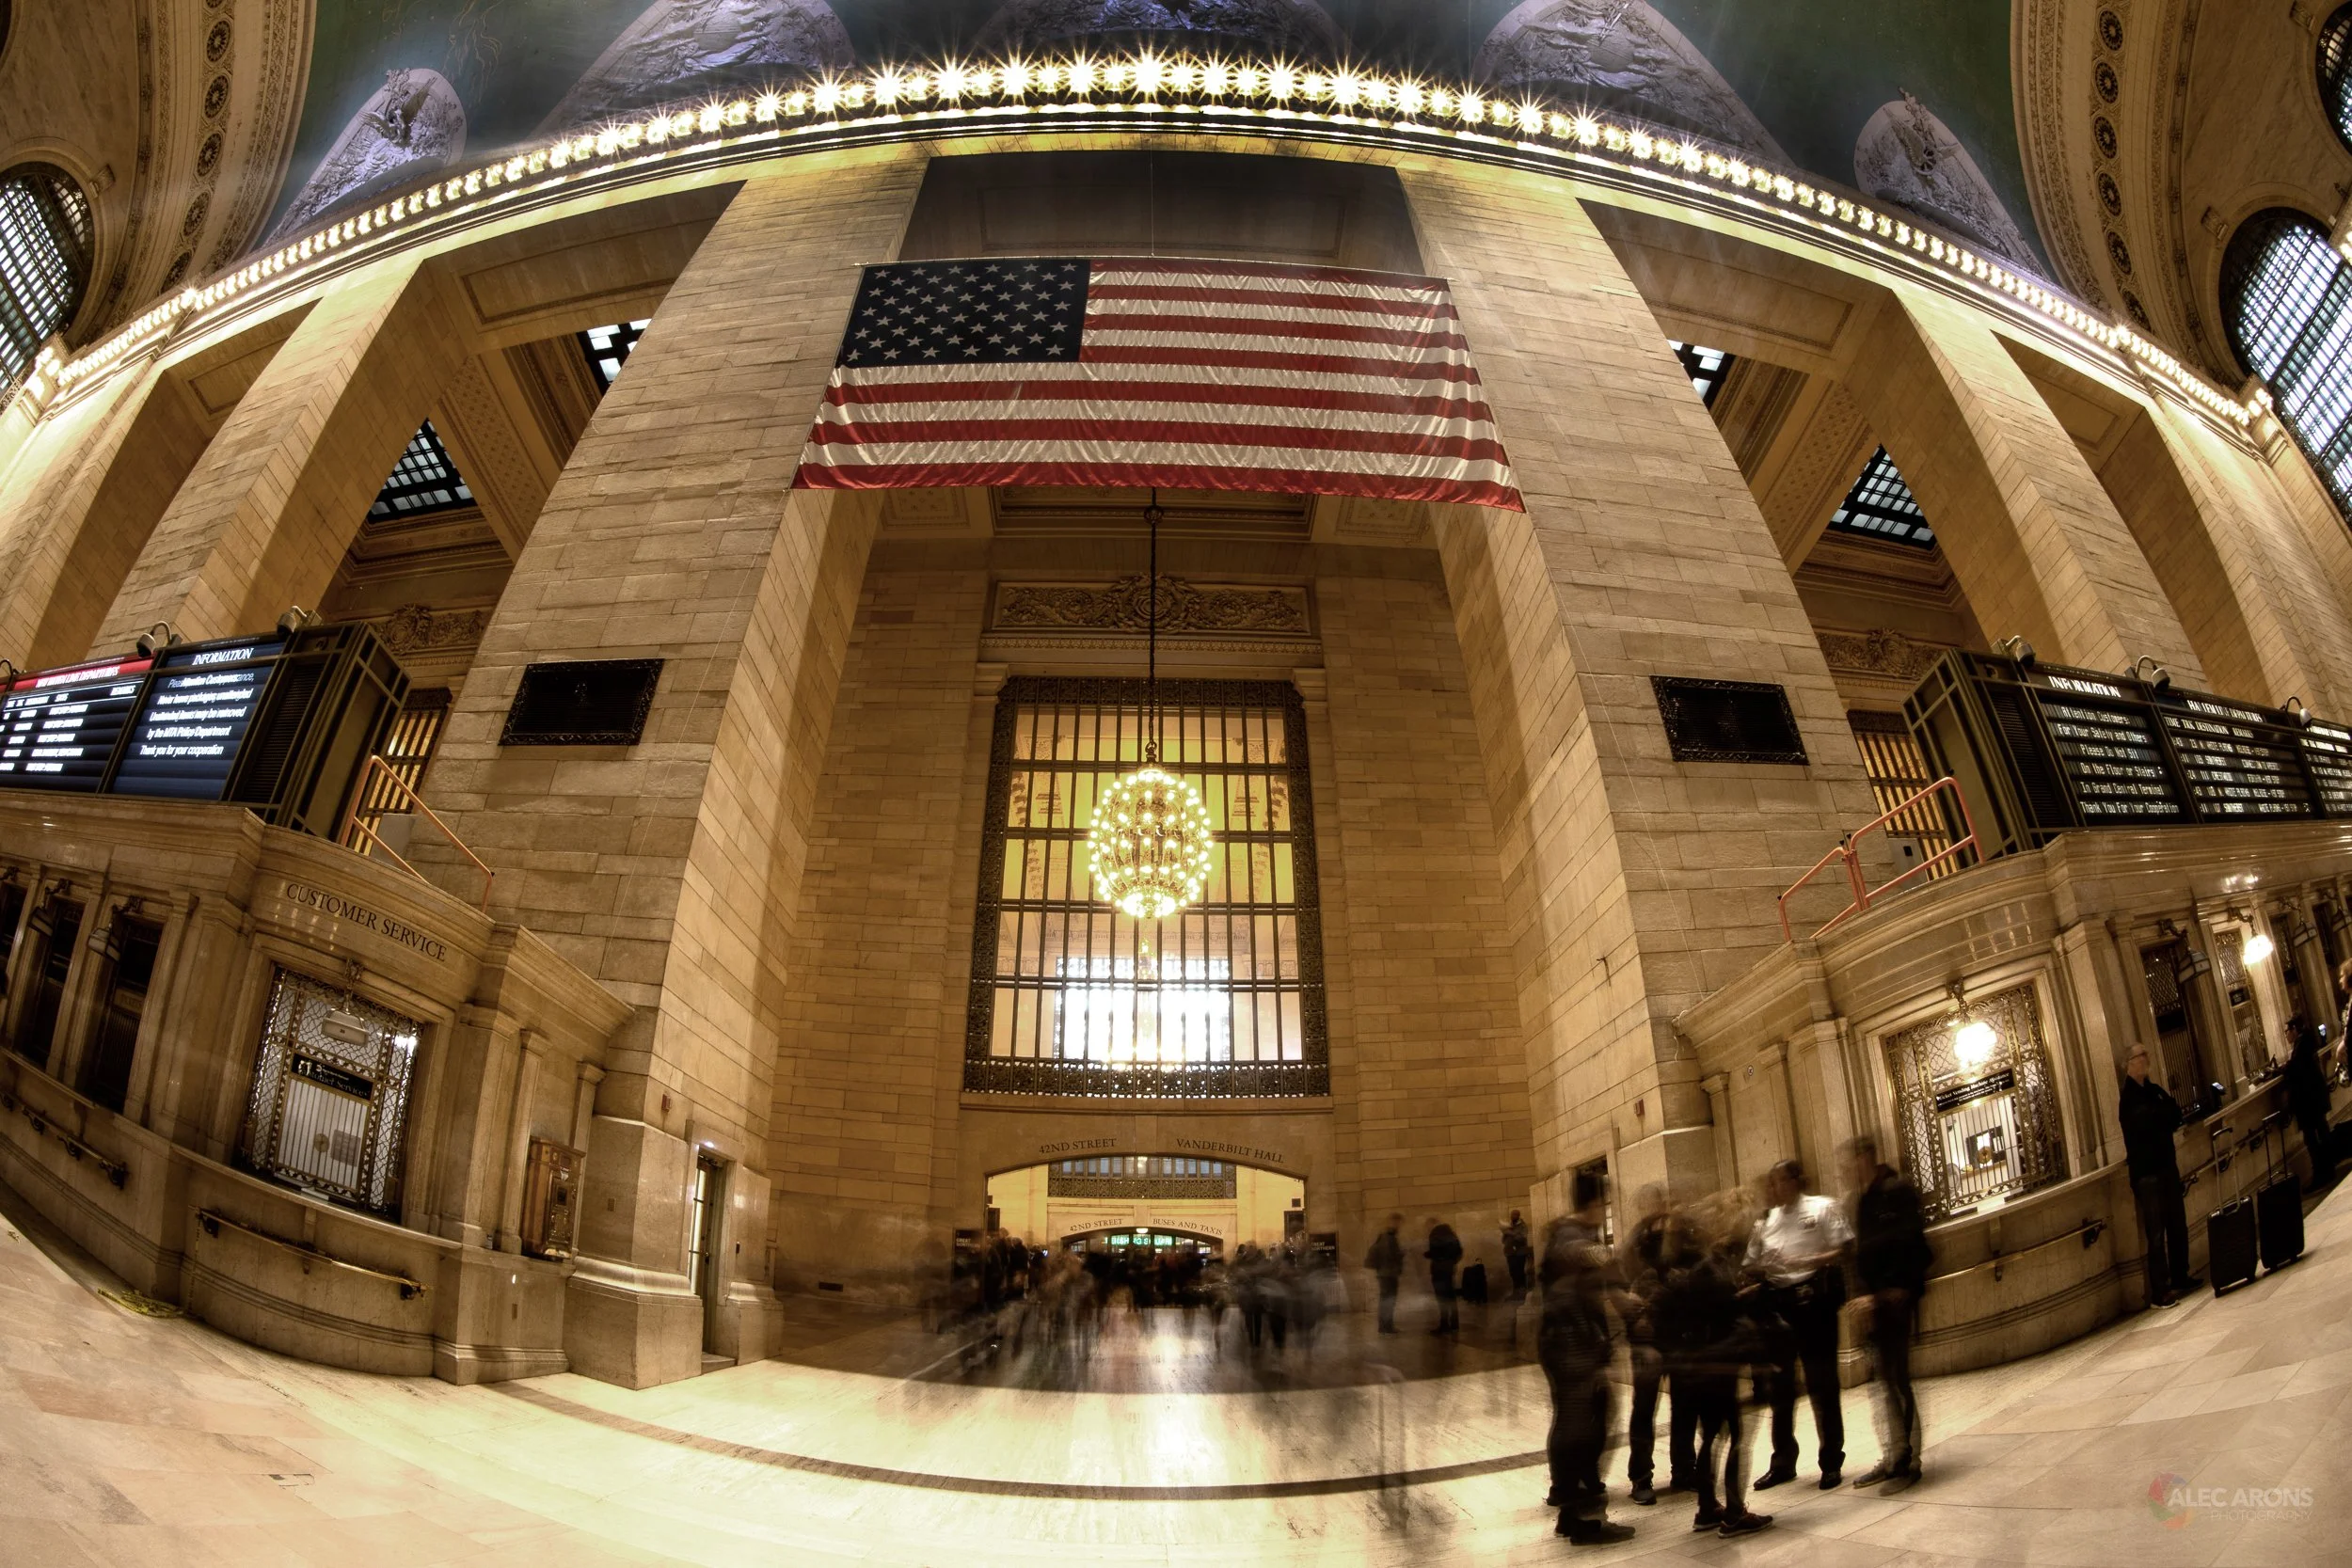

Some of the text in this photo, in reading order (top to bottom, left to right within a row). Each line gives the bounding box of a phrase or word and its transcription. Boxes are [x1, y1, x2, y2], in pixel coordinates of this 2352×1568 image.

[192, 647, 254, 665] INFORMATION
[2048, 675, 2122, 697] INFORMATION
[2060, 706, 2097, 721] Attention
[2164, 717, 2180, 727] TIME
[163, 728, 179, 736] MTA
[2058, 724, 2072, 735] For
[2073, 725, 2090, 736] Your
[2090, 727, 2113, 739] Safety
[2114, 732, 2126, 740] and
[154, 747, 167, 756] you
[173, 747, 188, 756] your
[186, 745, 224, 757] cooperation
[2080, 744, 2105, 756] Please
[2080, 763, 2090, 773] On
[2092, 764, 2105, 774] the
[2106, 764, 2125, 775] Floor
[2135, 767, 2155, 778] Stairs
[2080, 783, 2164, 795] In Grand Central Terminal
[2080, 802, 2102, 813] Thank
[2102, 802, 2116, 813] You
[2116, 802, 2129, 812] For
[286, 883, 447, 962] CUSTOMER SERVICE
[1039, 1138, 1117, 1154] 42ND STREET
[1176, 1138, 1284, 1164] VANDERBILT HALL
[1070, 1218, 1123, 1232] 42ND STREET
[1152, 1218, 1223, 1236] BUSES AND TAXIS
